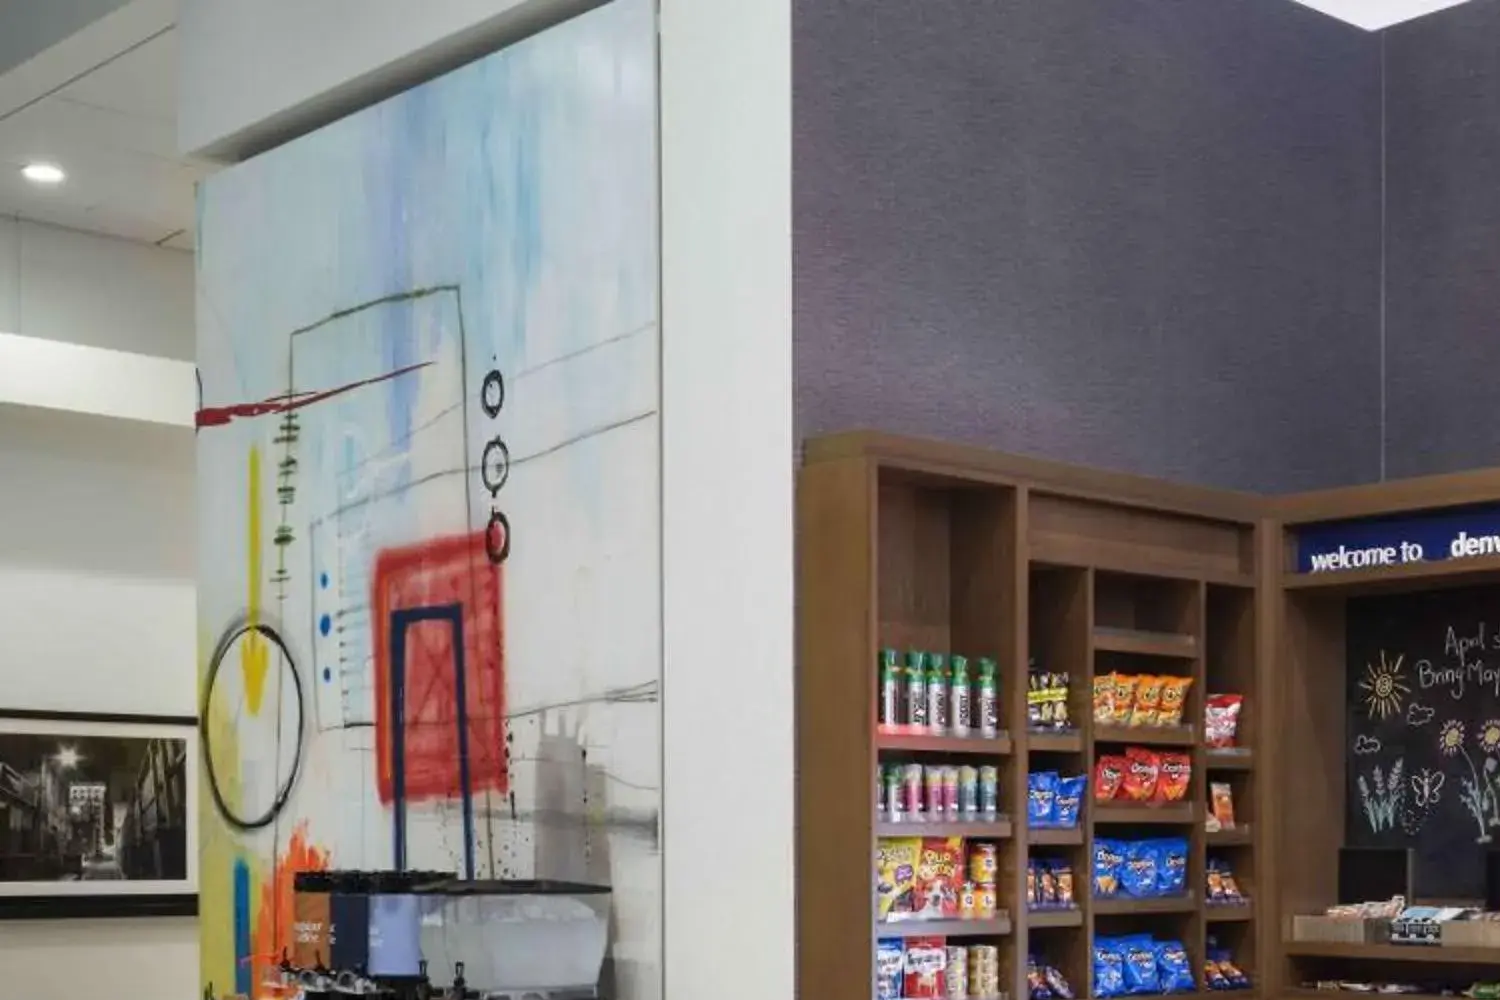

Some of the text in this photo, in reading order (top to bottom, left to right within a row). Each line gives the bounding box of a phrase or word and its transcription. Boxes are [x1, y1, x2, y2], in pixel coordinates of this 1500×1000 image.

[1311, 545, 1396, 572] welcome
[1400, 541, 1423, 562] to
[1444, 622, 1486, 667] April
[1416, 659, 1500, 699] Bring May
